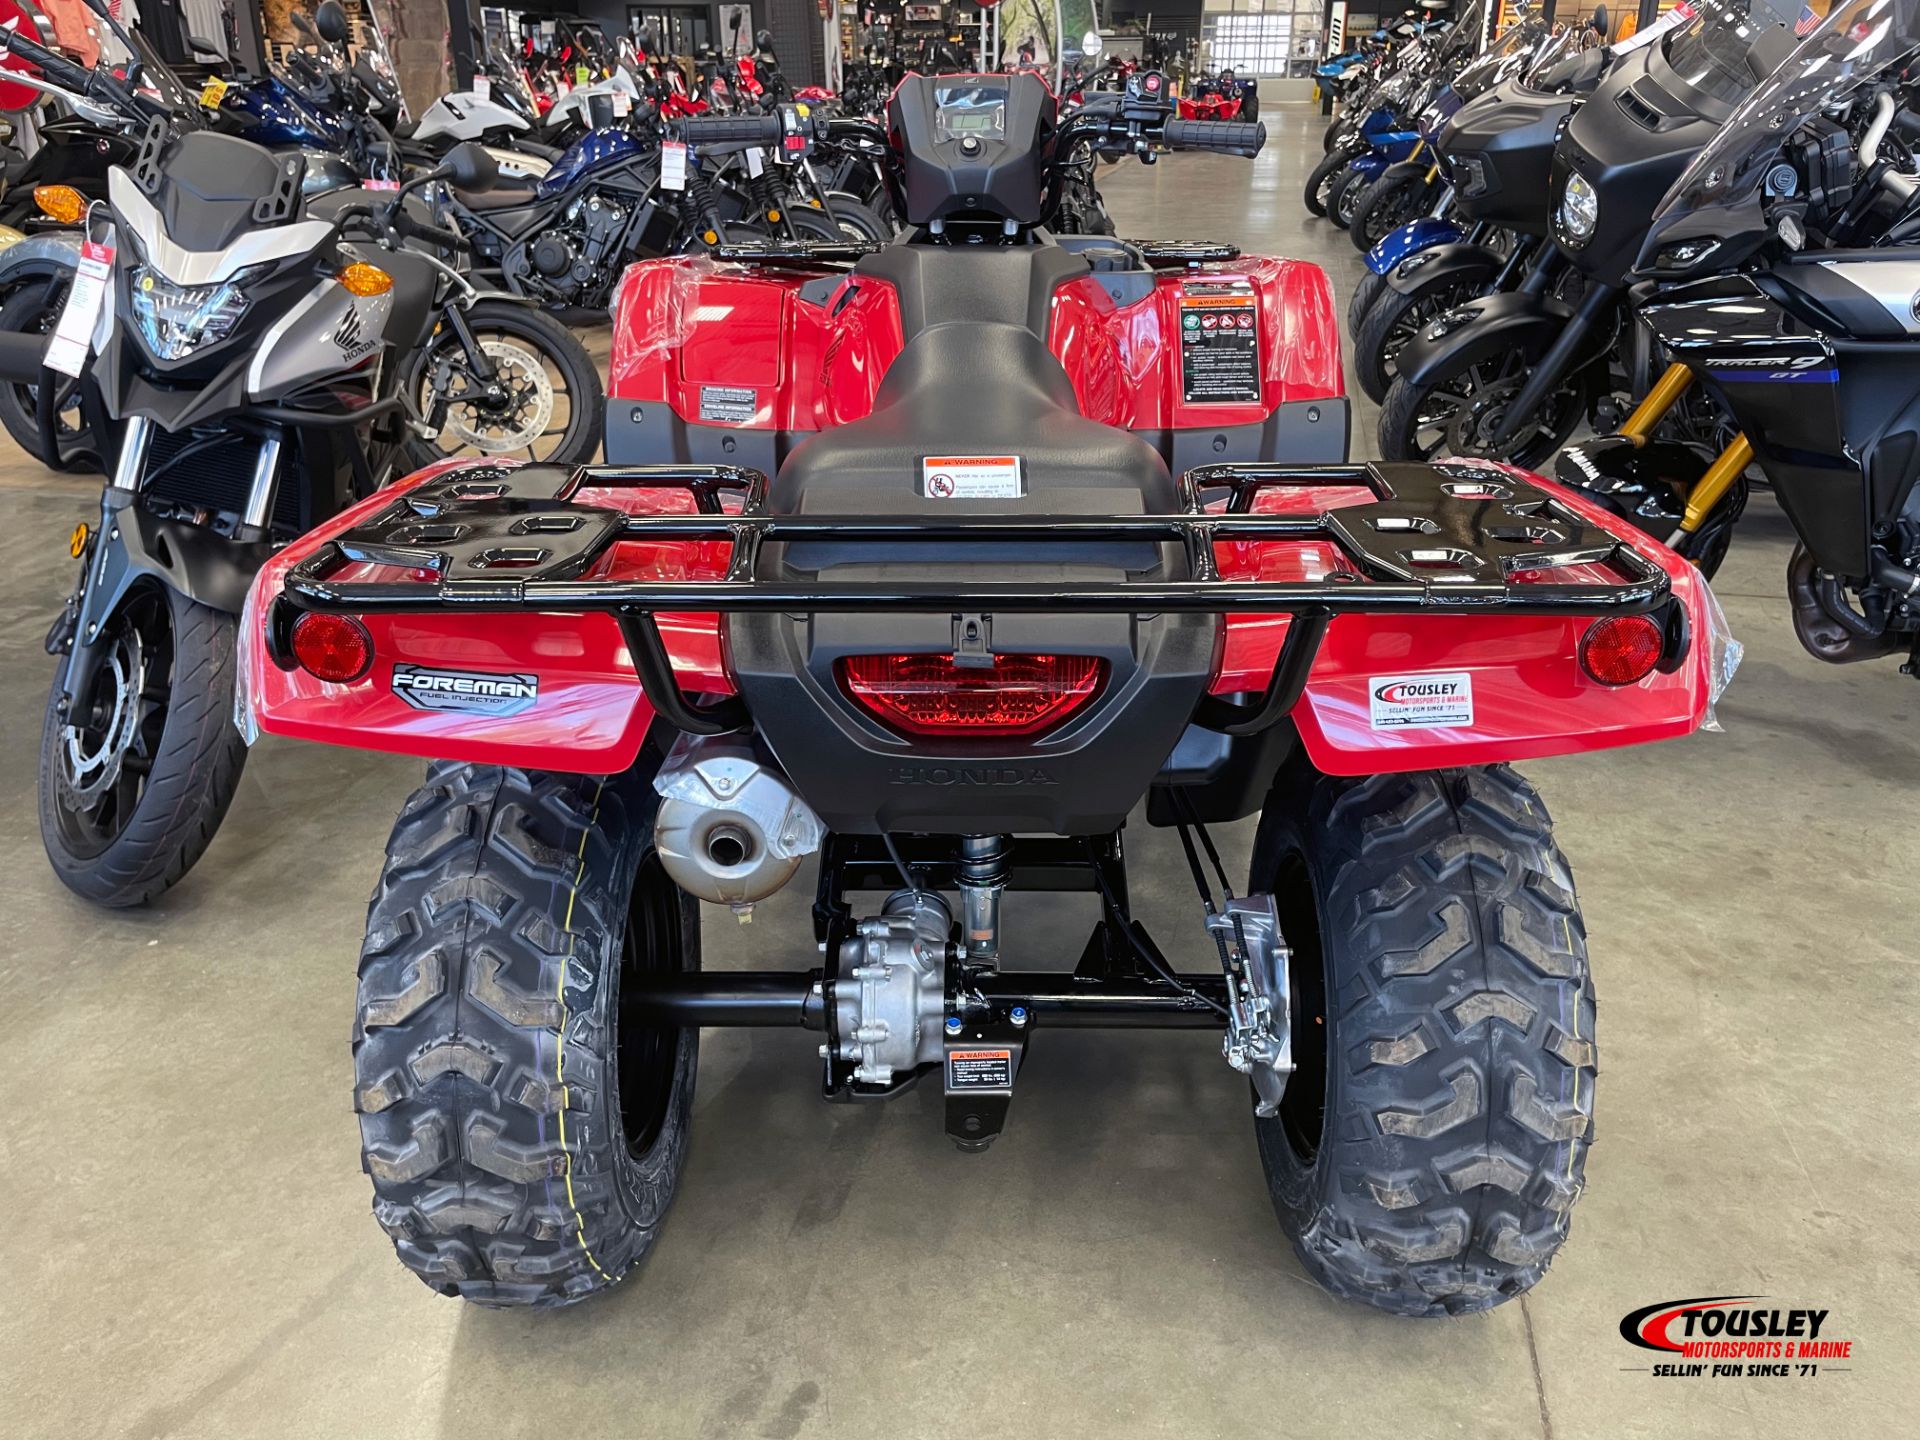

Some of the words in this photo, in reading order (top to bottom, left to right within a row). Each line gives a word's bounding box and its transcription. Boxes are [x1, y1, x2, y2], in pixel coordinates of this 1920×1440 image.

[342, 339, 376, 362] HONDA
[1704, 357, 1791, 366] TRACER
[1790, 356, 1826, 369] 9
[392, 673, 537, 698] FOREMAN
[1400, 683, 1457, 697] TOUSLEY
[451, 695, 508, 704] INJECTION
[1400, 696, 1440, 705] MOTORSPORTS
[888, 769, 1060, 785] HONDA
